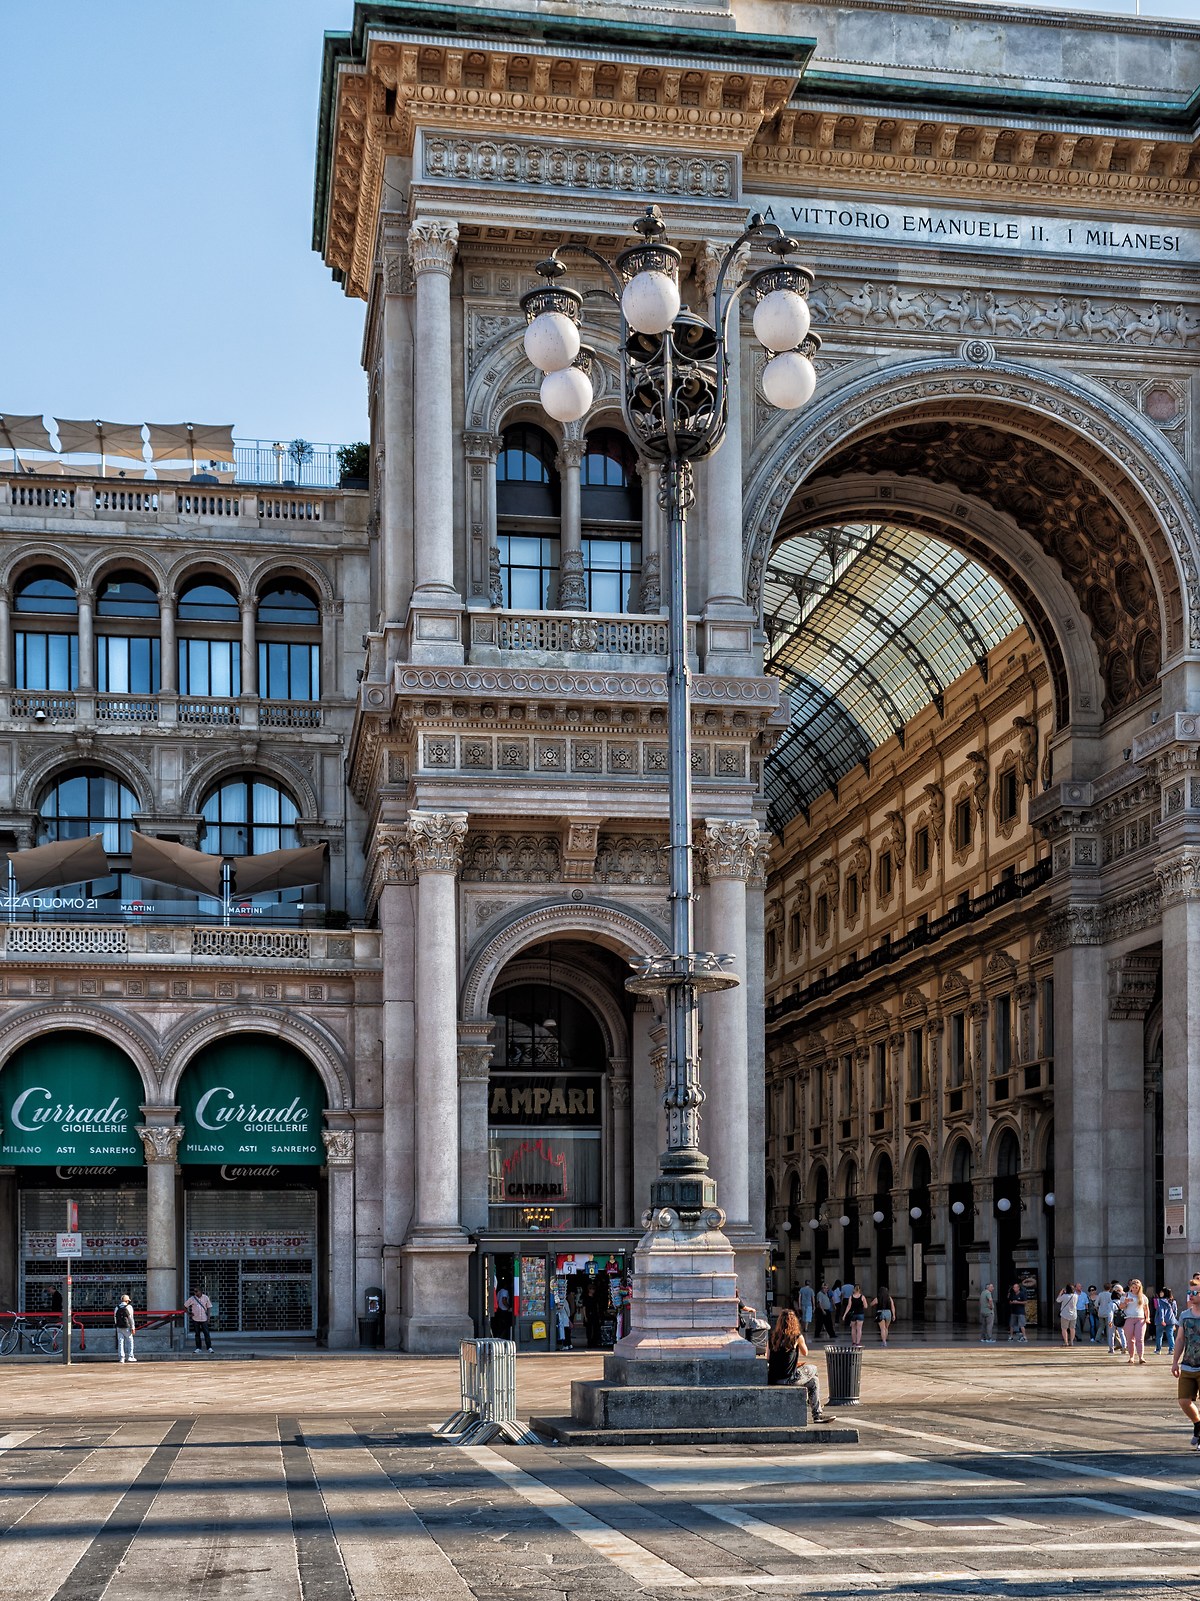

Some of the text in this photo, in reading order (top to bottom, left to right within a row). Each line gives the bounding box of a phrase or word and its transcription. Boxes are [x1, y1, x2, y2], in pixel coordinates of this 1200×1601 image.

[764, 205, 1180, 252] A VITTORIO EMANUELE II. I MILANESI
[33, 898, 84, 909] DUOMO
[87, 899, 98, 909] 21
[490, 1088, 595, 1114] AMPARI
[11, 1087, 128, 1132] Currado
[195, 1087, 309, 1131] Currado
[61, 1125, 127, 1133] GIOIELLERIE
[244, 1124, 308, 1132] GIOIELLERIE
[187, 1144, 224, 1152] MILANO
[508, 1183, 562, 1195] CAMPARI
